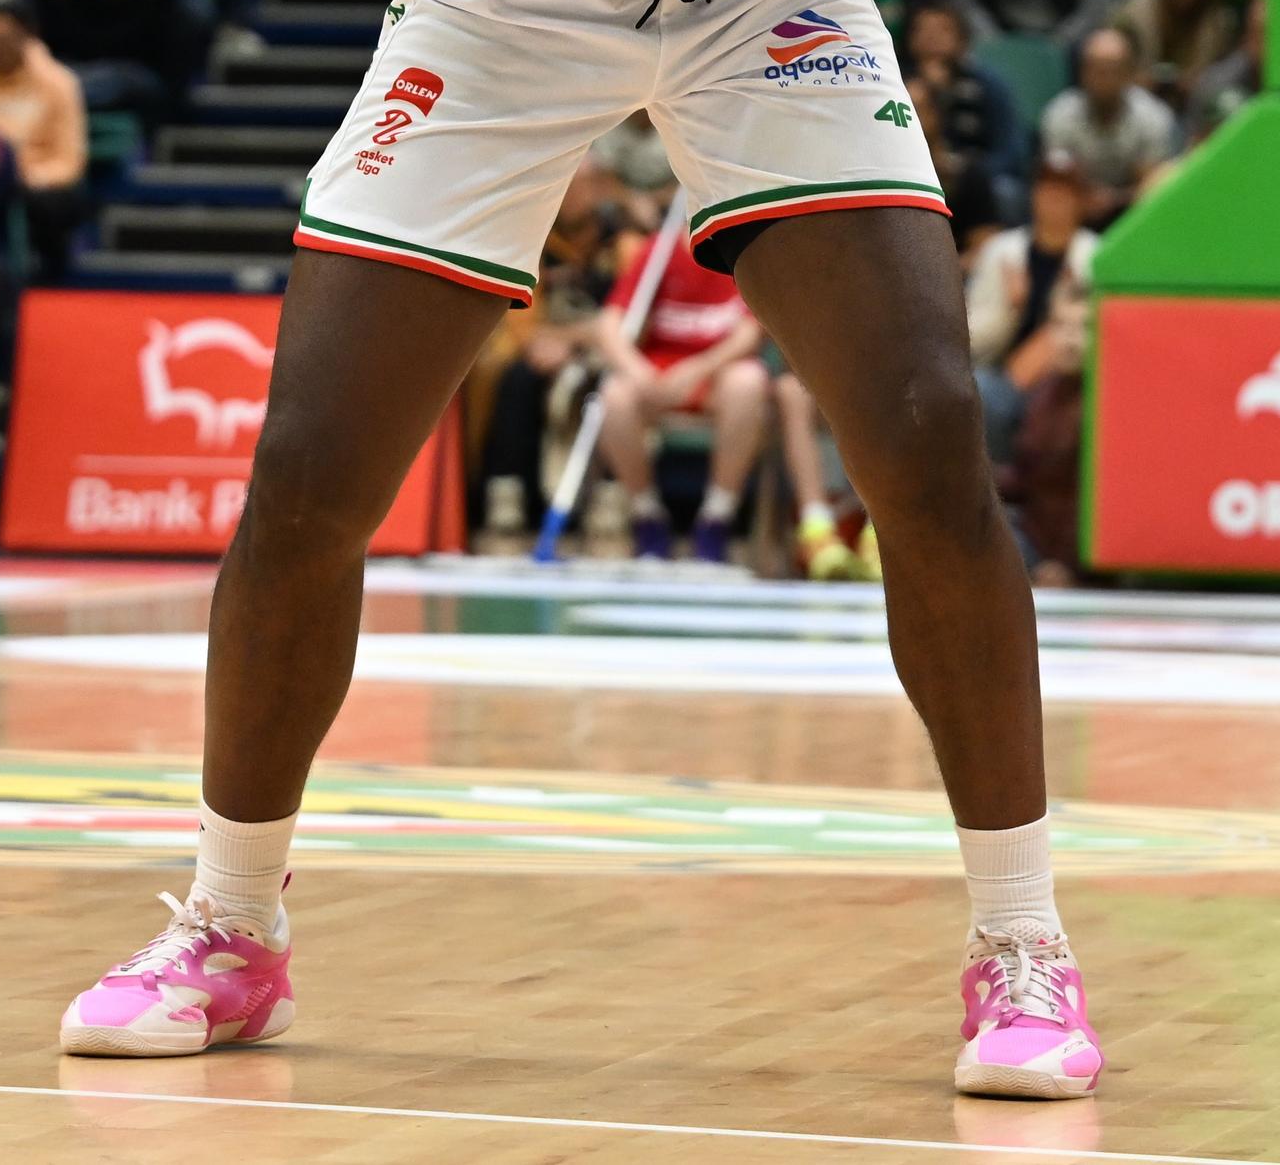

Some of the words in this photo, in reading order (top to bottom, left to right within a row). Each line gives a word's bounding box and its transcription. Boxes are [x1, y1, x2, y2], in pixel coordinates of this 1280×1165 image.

[764, 51, 881, 80] aquapark
[395, 79, 439, 101] ORLEN
[874, 100, 912, 128] 4F
[354, 150, 395, 166] asket
[356, 159, 381, 175] Liga
[66, 477, 204, 531] Bank
